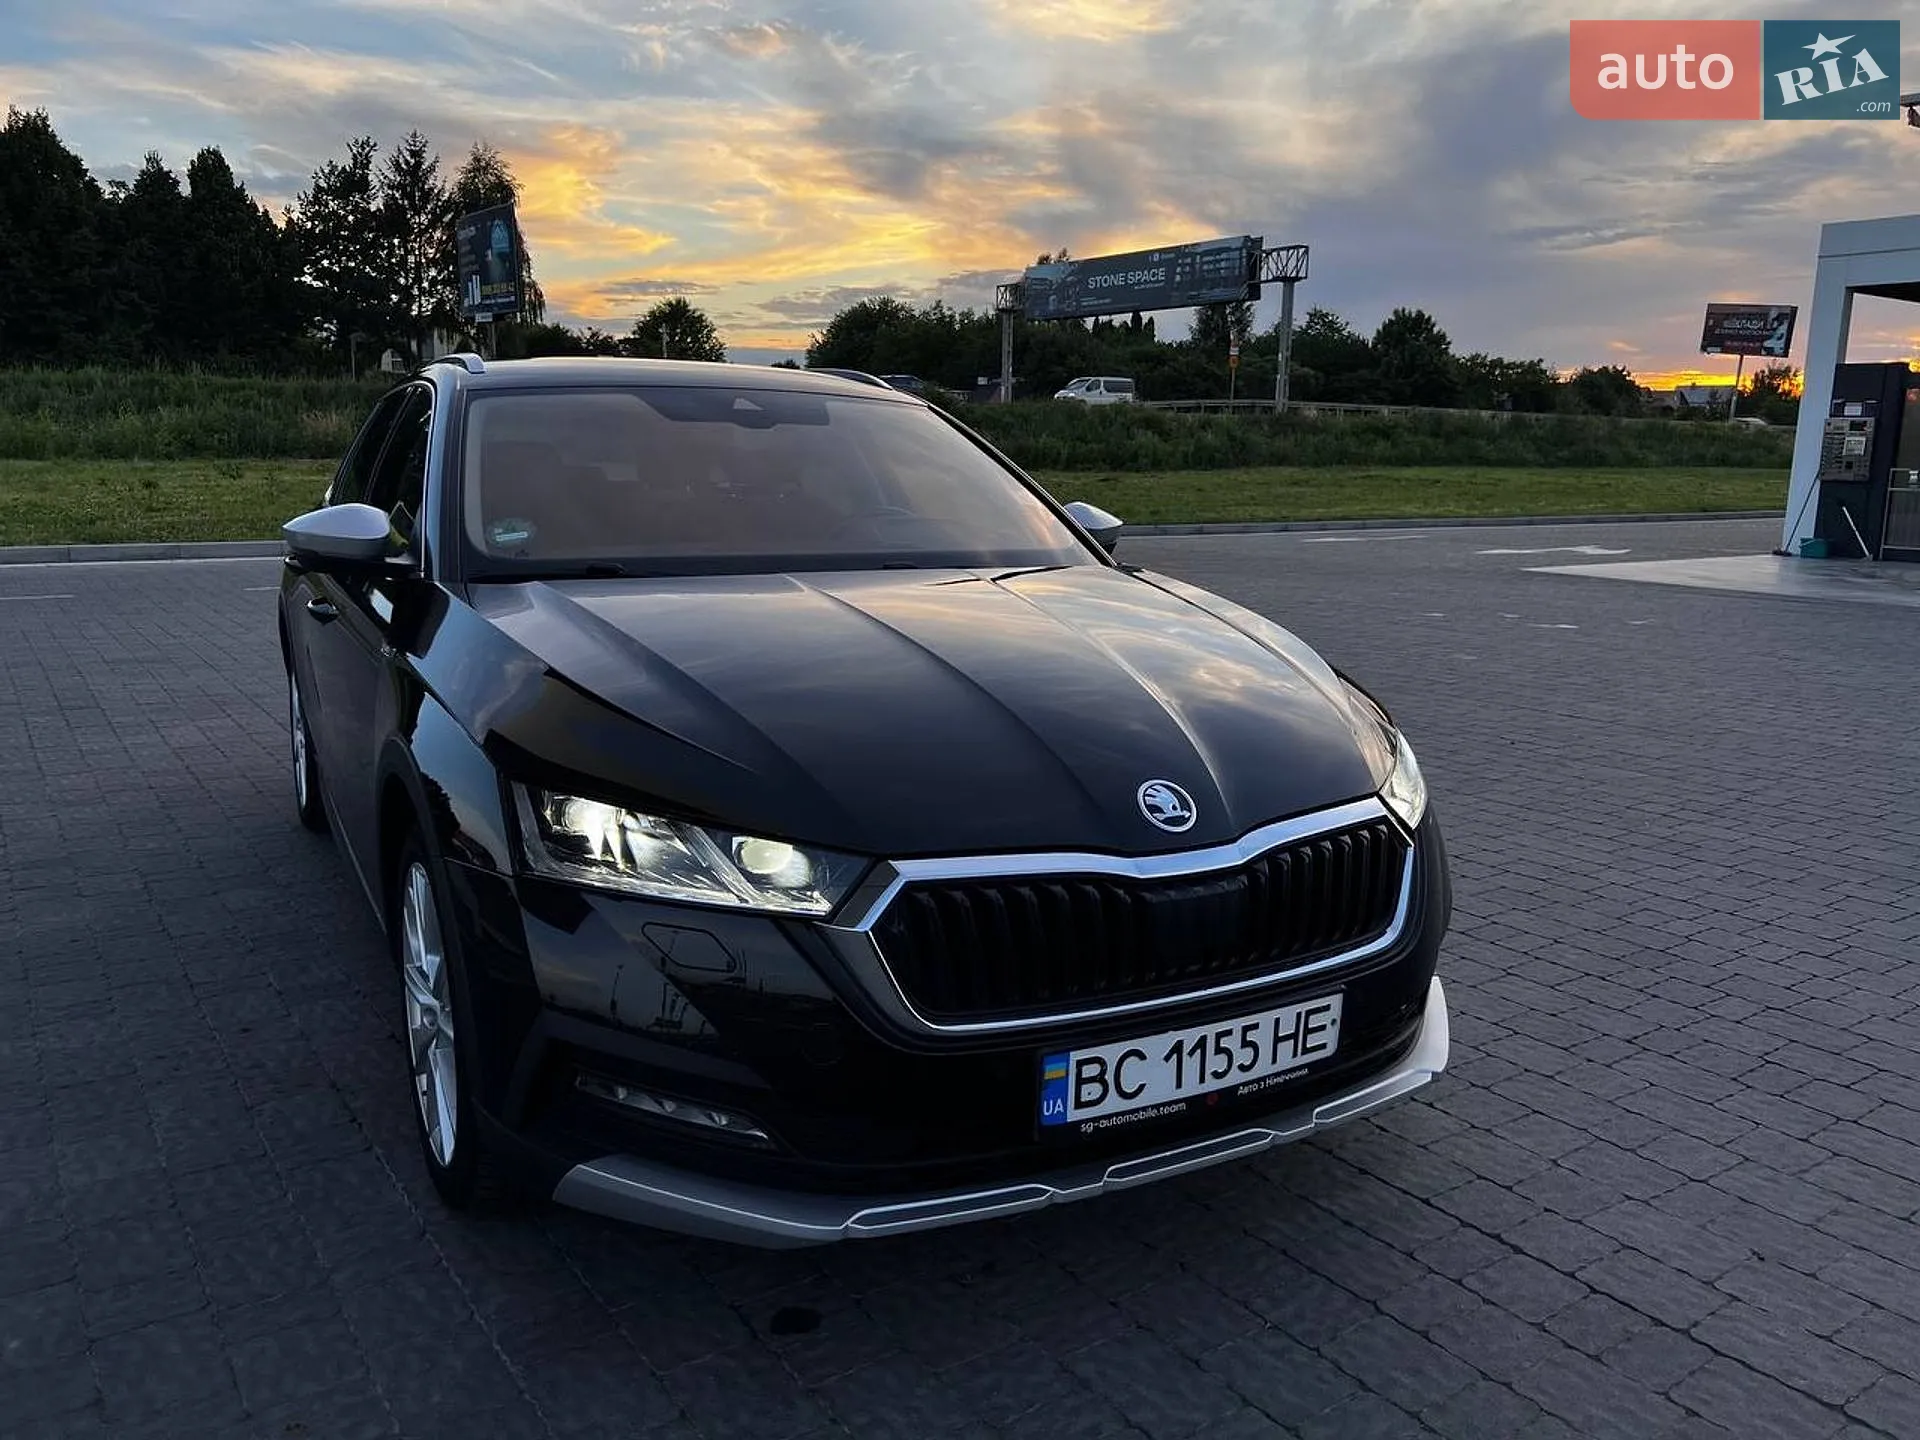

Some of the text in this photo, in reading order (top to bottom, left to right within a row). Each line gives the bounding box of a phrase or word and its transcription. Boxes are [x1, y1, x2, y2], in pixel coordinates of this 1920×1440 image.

[1087, 273, 1126, 290] STONE
[1126, 267, 1166, 284] SPACE
[1073, 1003, 1332, 1110] BC 1155 HE
[1043, 1099, 1065, 1116] UA
